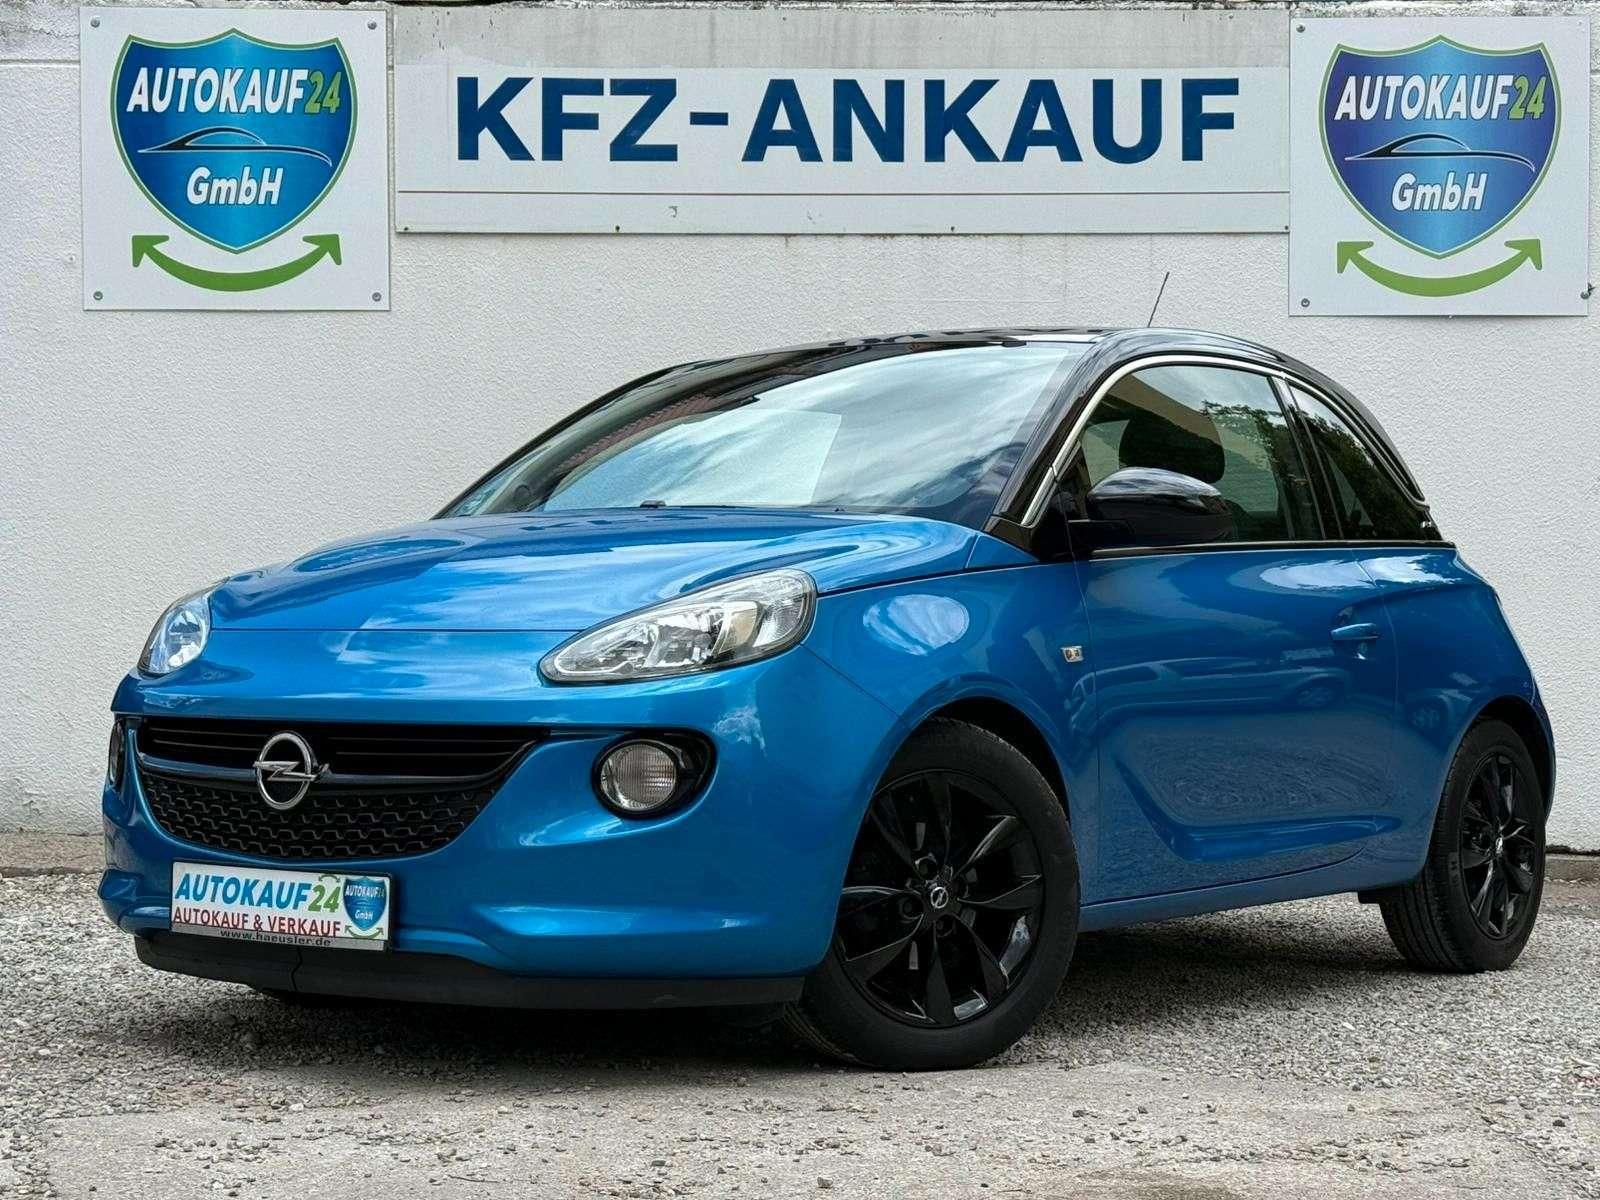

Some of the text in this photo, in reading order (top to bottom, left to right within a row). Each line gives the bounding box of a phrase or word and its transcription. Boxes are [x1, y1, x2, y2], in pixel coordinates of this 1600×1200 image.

[126, 67, 342, 114] AUTOKAUF24
[1334, 74, 1546, 121] AUTOKAUF24
[457, 77, 1240, 164] KFZ-ANKAUF
[186, 166, 284, 206] GmbH
[1391, 171, 1488, 210] GmbH
[174, 873, 341, 913] AUTOKAUF24
[173, 906, 341, 938] AUTOKAUF & VERKAUF
[220, 929, 331, 947] www.haeusler.de
